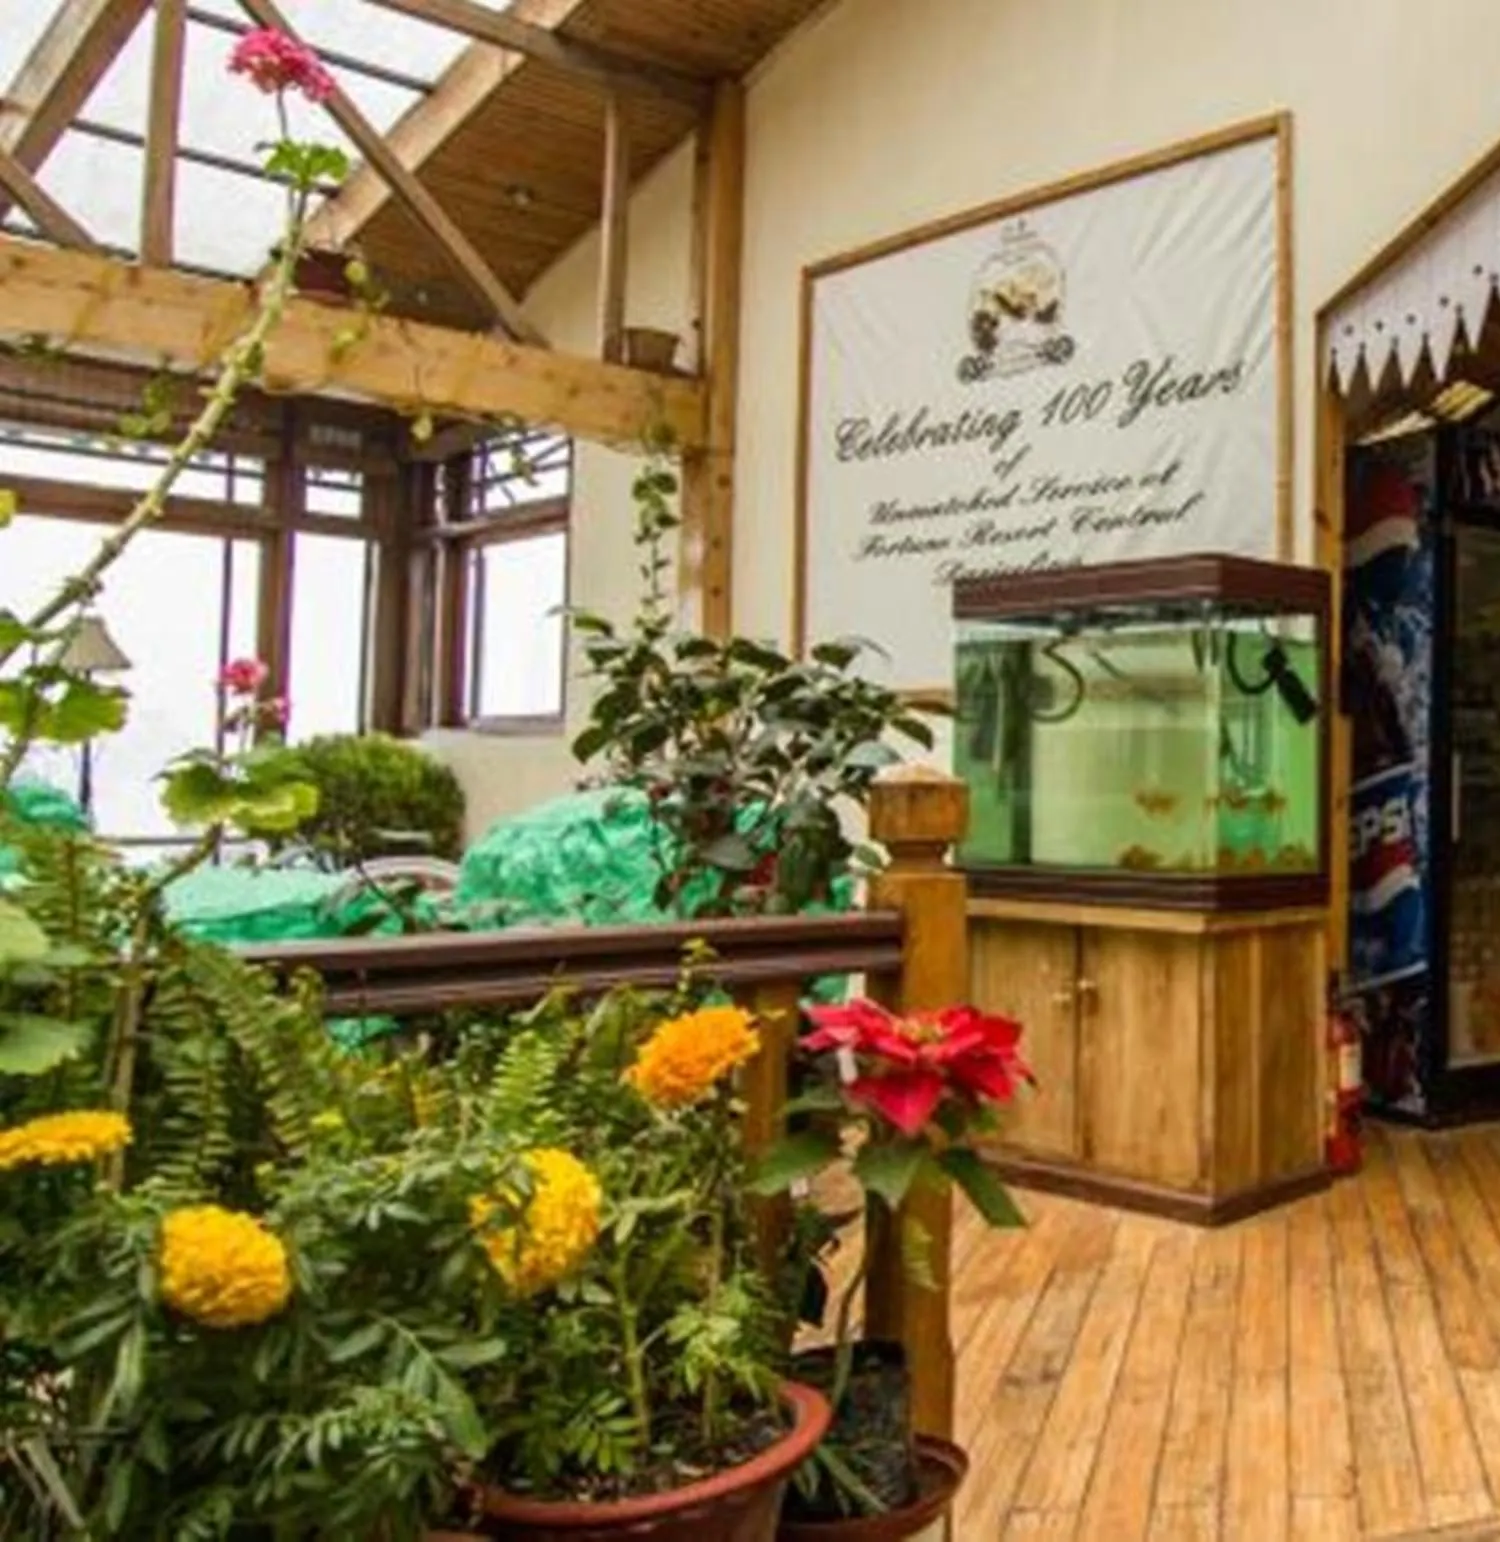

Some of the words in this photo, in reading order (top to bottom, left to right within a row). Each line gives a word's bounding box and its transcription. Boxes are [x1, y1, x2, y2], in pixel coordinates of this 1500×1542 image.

[835, 408, 1021, 463] Celebrating
[1041, 382, 1109, 428] 100
[1121, 355, 1245, 428] Years
[993, 446, 1032, 478] of
[1138, 458, 1180, 487] at
